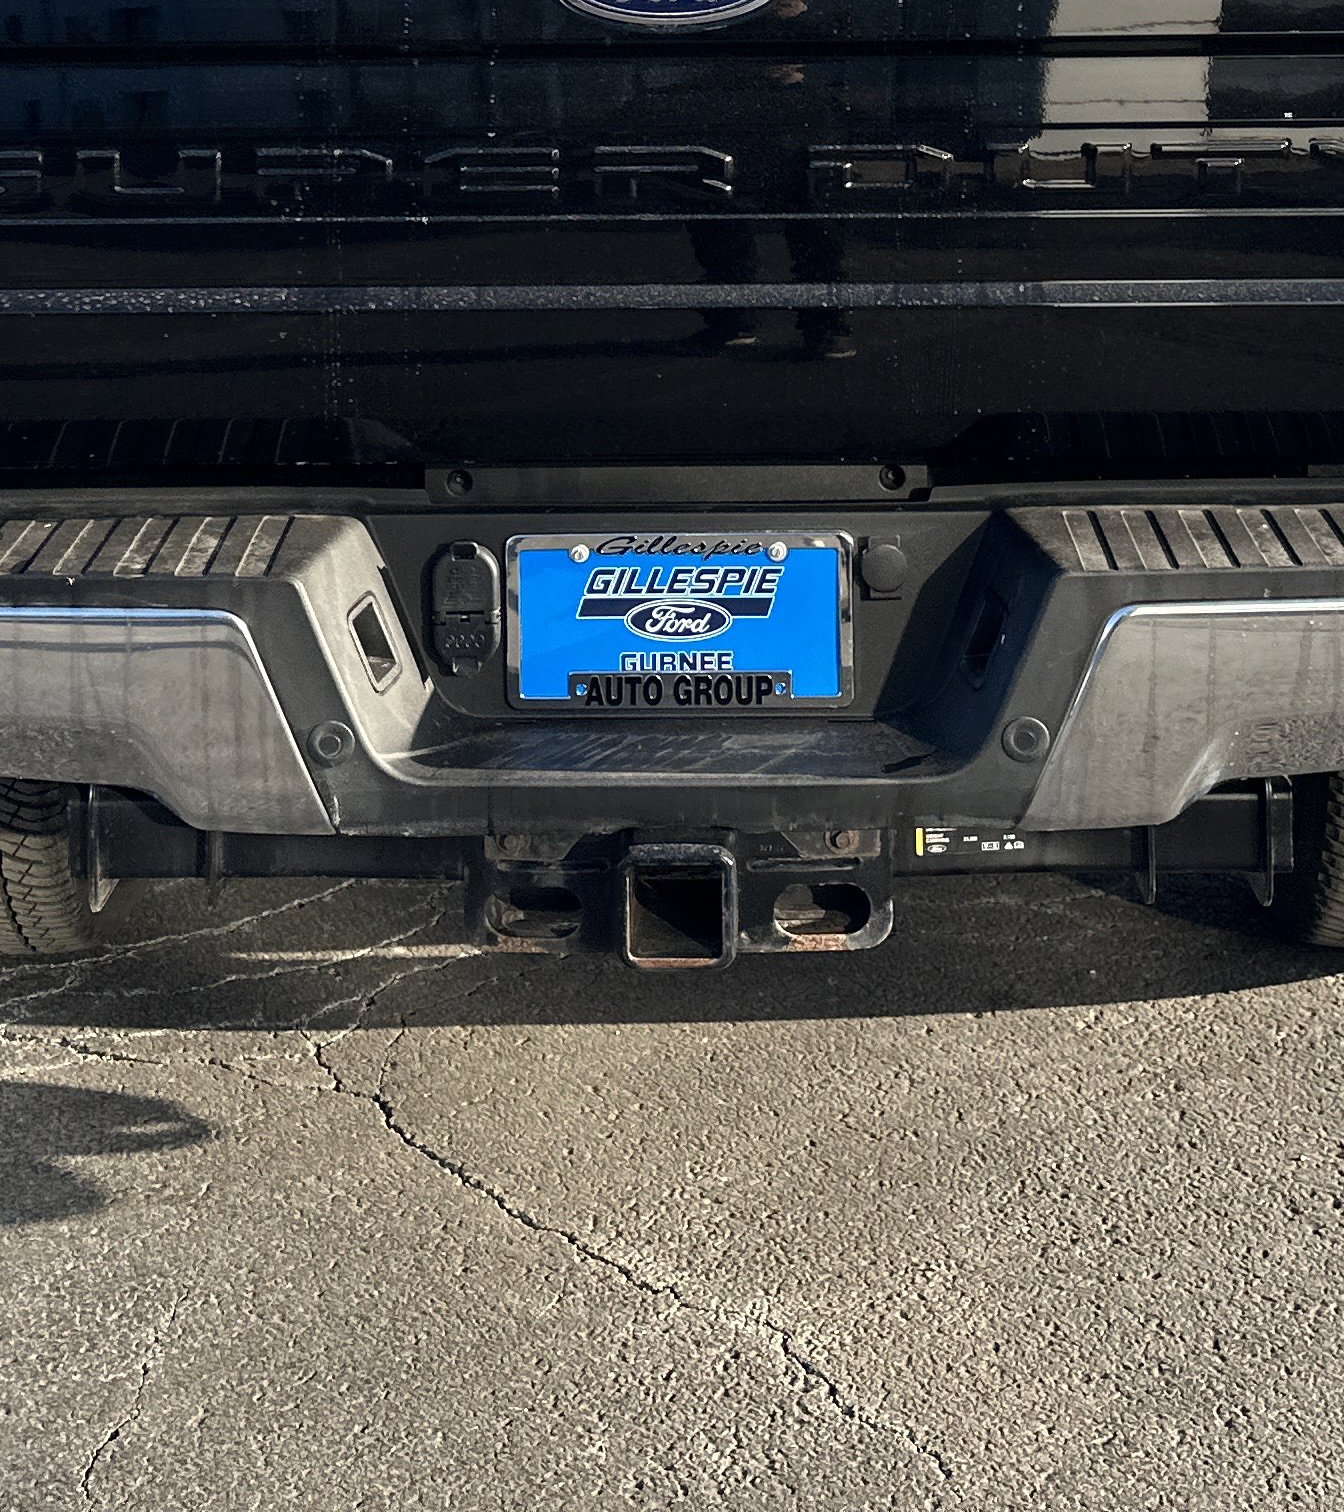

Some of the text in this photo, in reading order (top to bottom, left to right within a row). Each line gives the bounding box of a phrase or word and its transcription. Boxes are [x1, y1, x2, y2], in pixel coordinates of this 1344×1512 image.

[596, 535, 763, 560] Gillespie
[584, 566, 785, 596] GILLESPIE
[644, 605, 711, 633] Ford
[619, 651, 734, 672] GURNEE
[584, 675, 774, 706] AUTO GROUP
